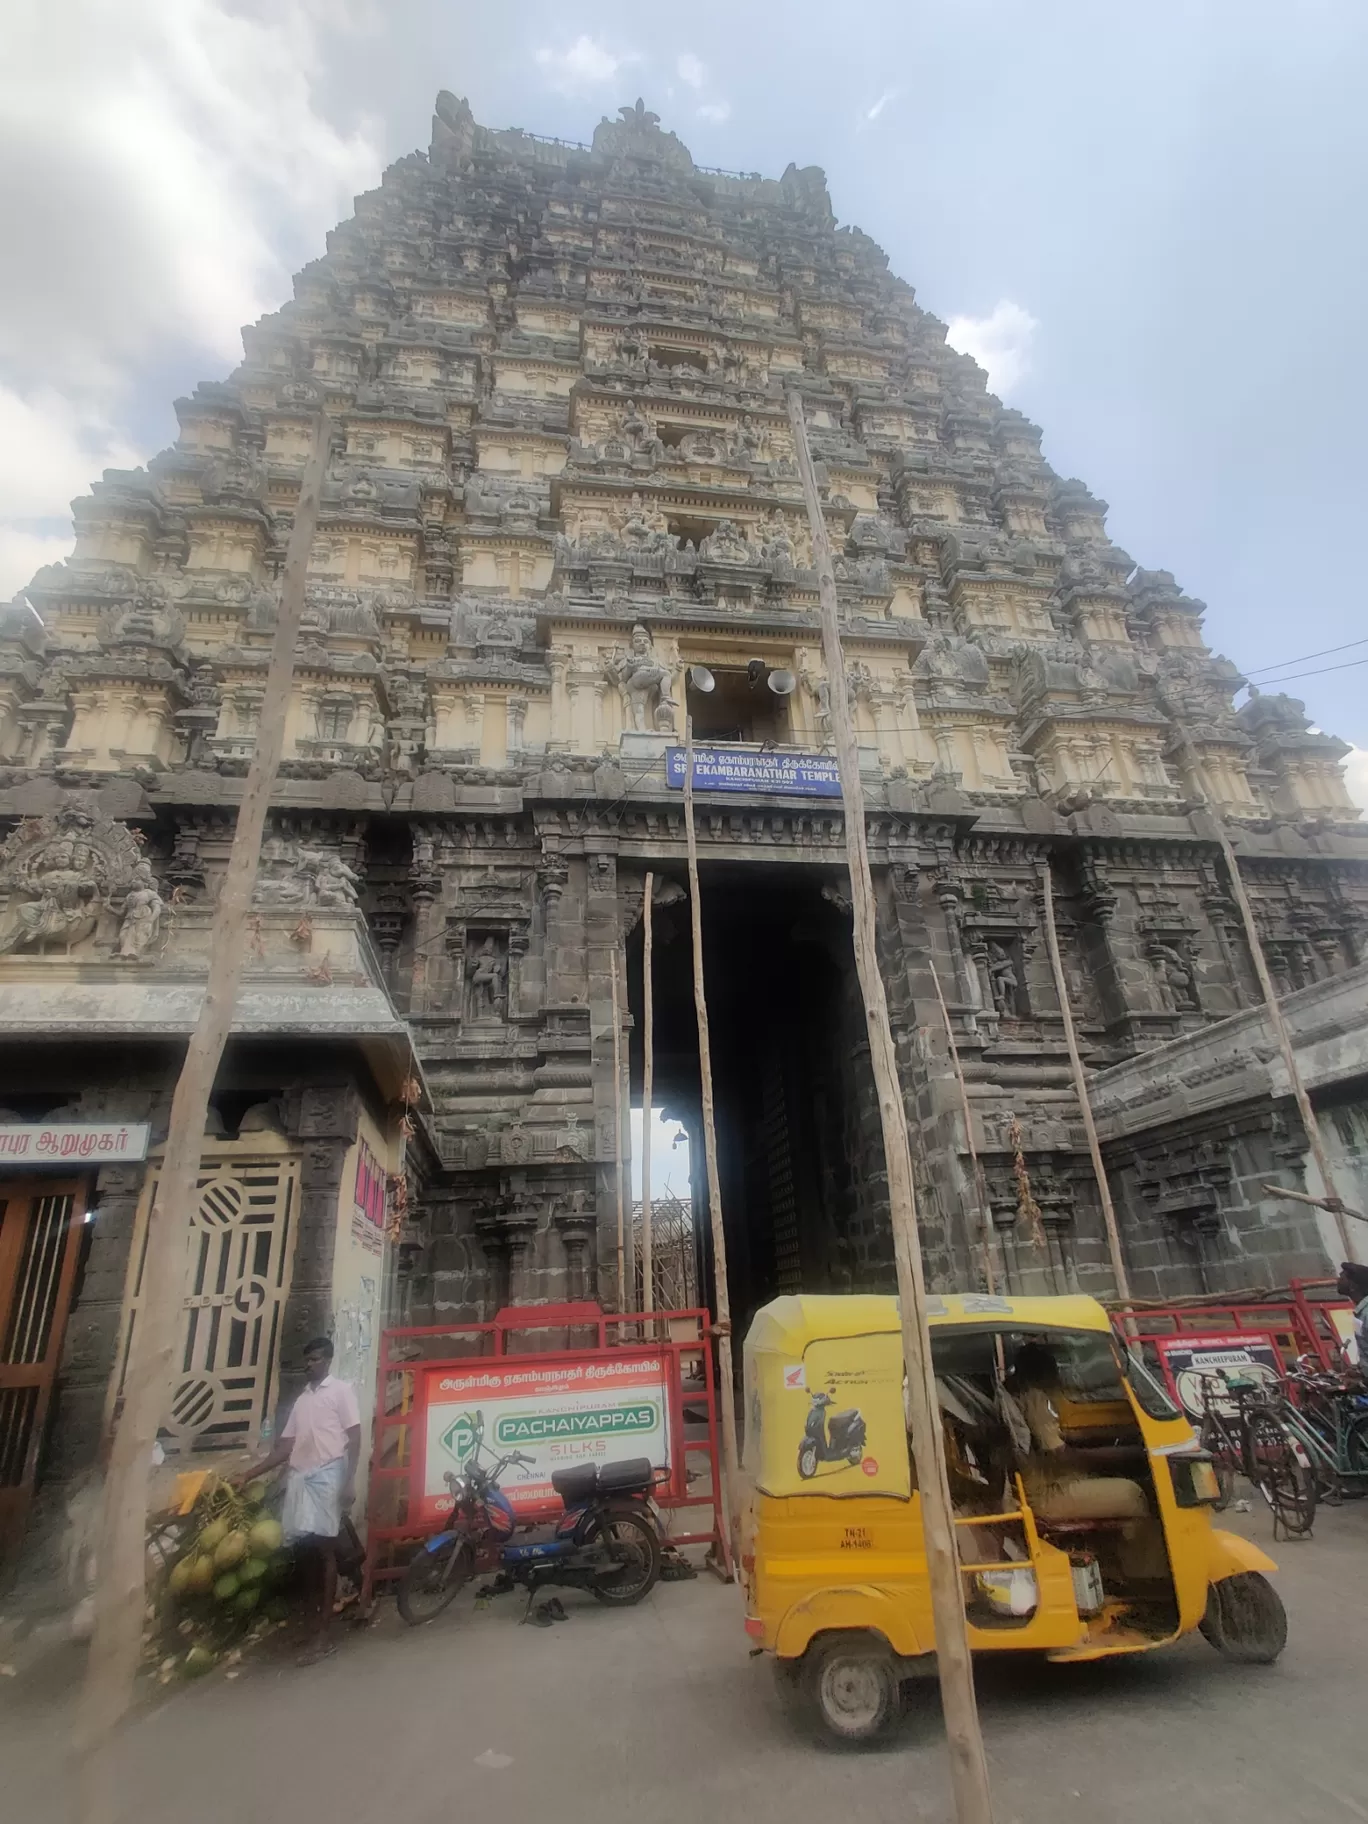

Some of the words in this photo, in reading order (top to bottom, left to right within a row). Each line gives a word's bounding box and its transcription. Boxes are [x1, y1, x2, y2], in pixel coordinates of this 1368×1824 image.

[696, 764, 797, 780] EKAMBARANATHAR
[800, 771, 841, 782] TEMPLE
[35, 1127, 128, 1156] ஆறுமுகர்
[1194, 1354, 1249, 1365] KANCHEEPURAM
[440, 1374, 502, 1391] அருள்மிகு
[503, 1369, 583, 1387] ஏகாம்பரநாதர்
[585, 1360, 661, 1379] திருக்கோயில்
[502, 1410, 651, 1437] PACHAIYAPPAS
[550, 1440, 607, 1456] SILKS
